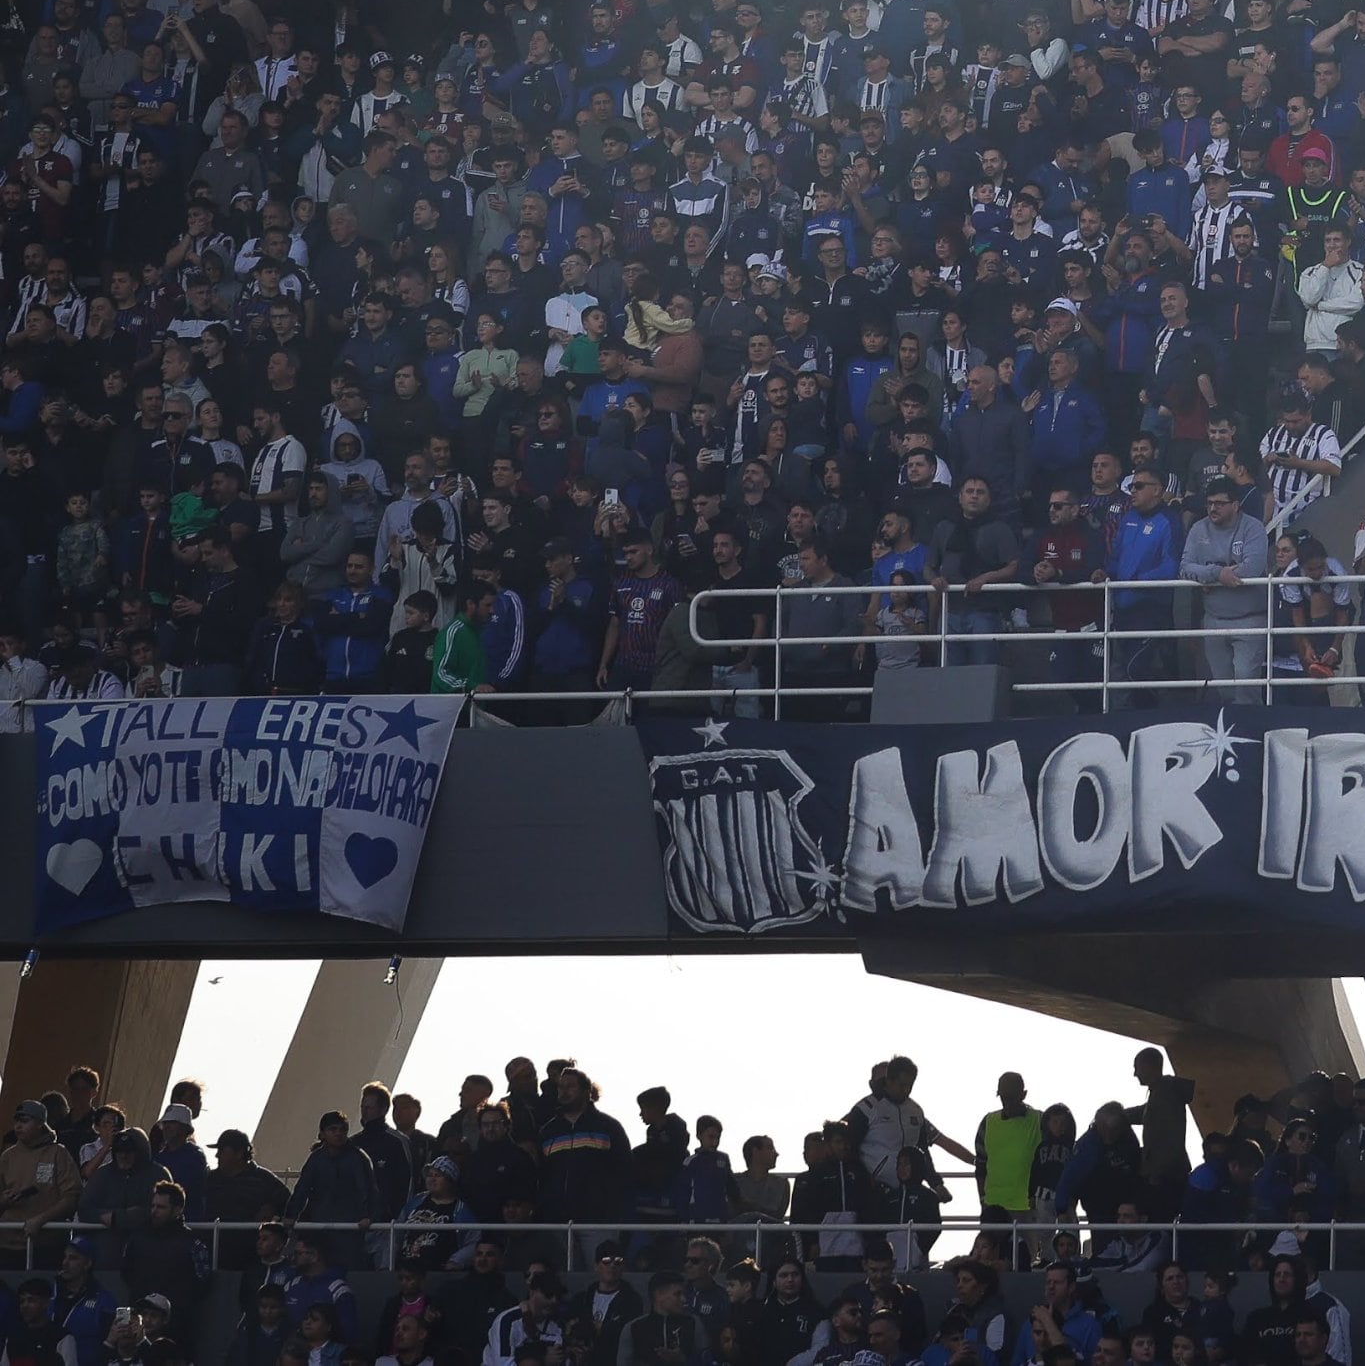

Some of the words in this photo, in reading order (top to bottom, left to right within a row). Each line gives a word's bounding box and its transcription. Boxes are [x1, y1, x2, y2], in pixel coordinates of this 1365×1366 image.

[91, 700, 220, 747] TALL
[256, 699, 372, 749] ERES
[48, 757, 128, 827] COMO
[681, 764, 758, 789] C.A.T
[840, 722, 1223, 913] AMOR
